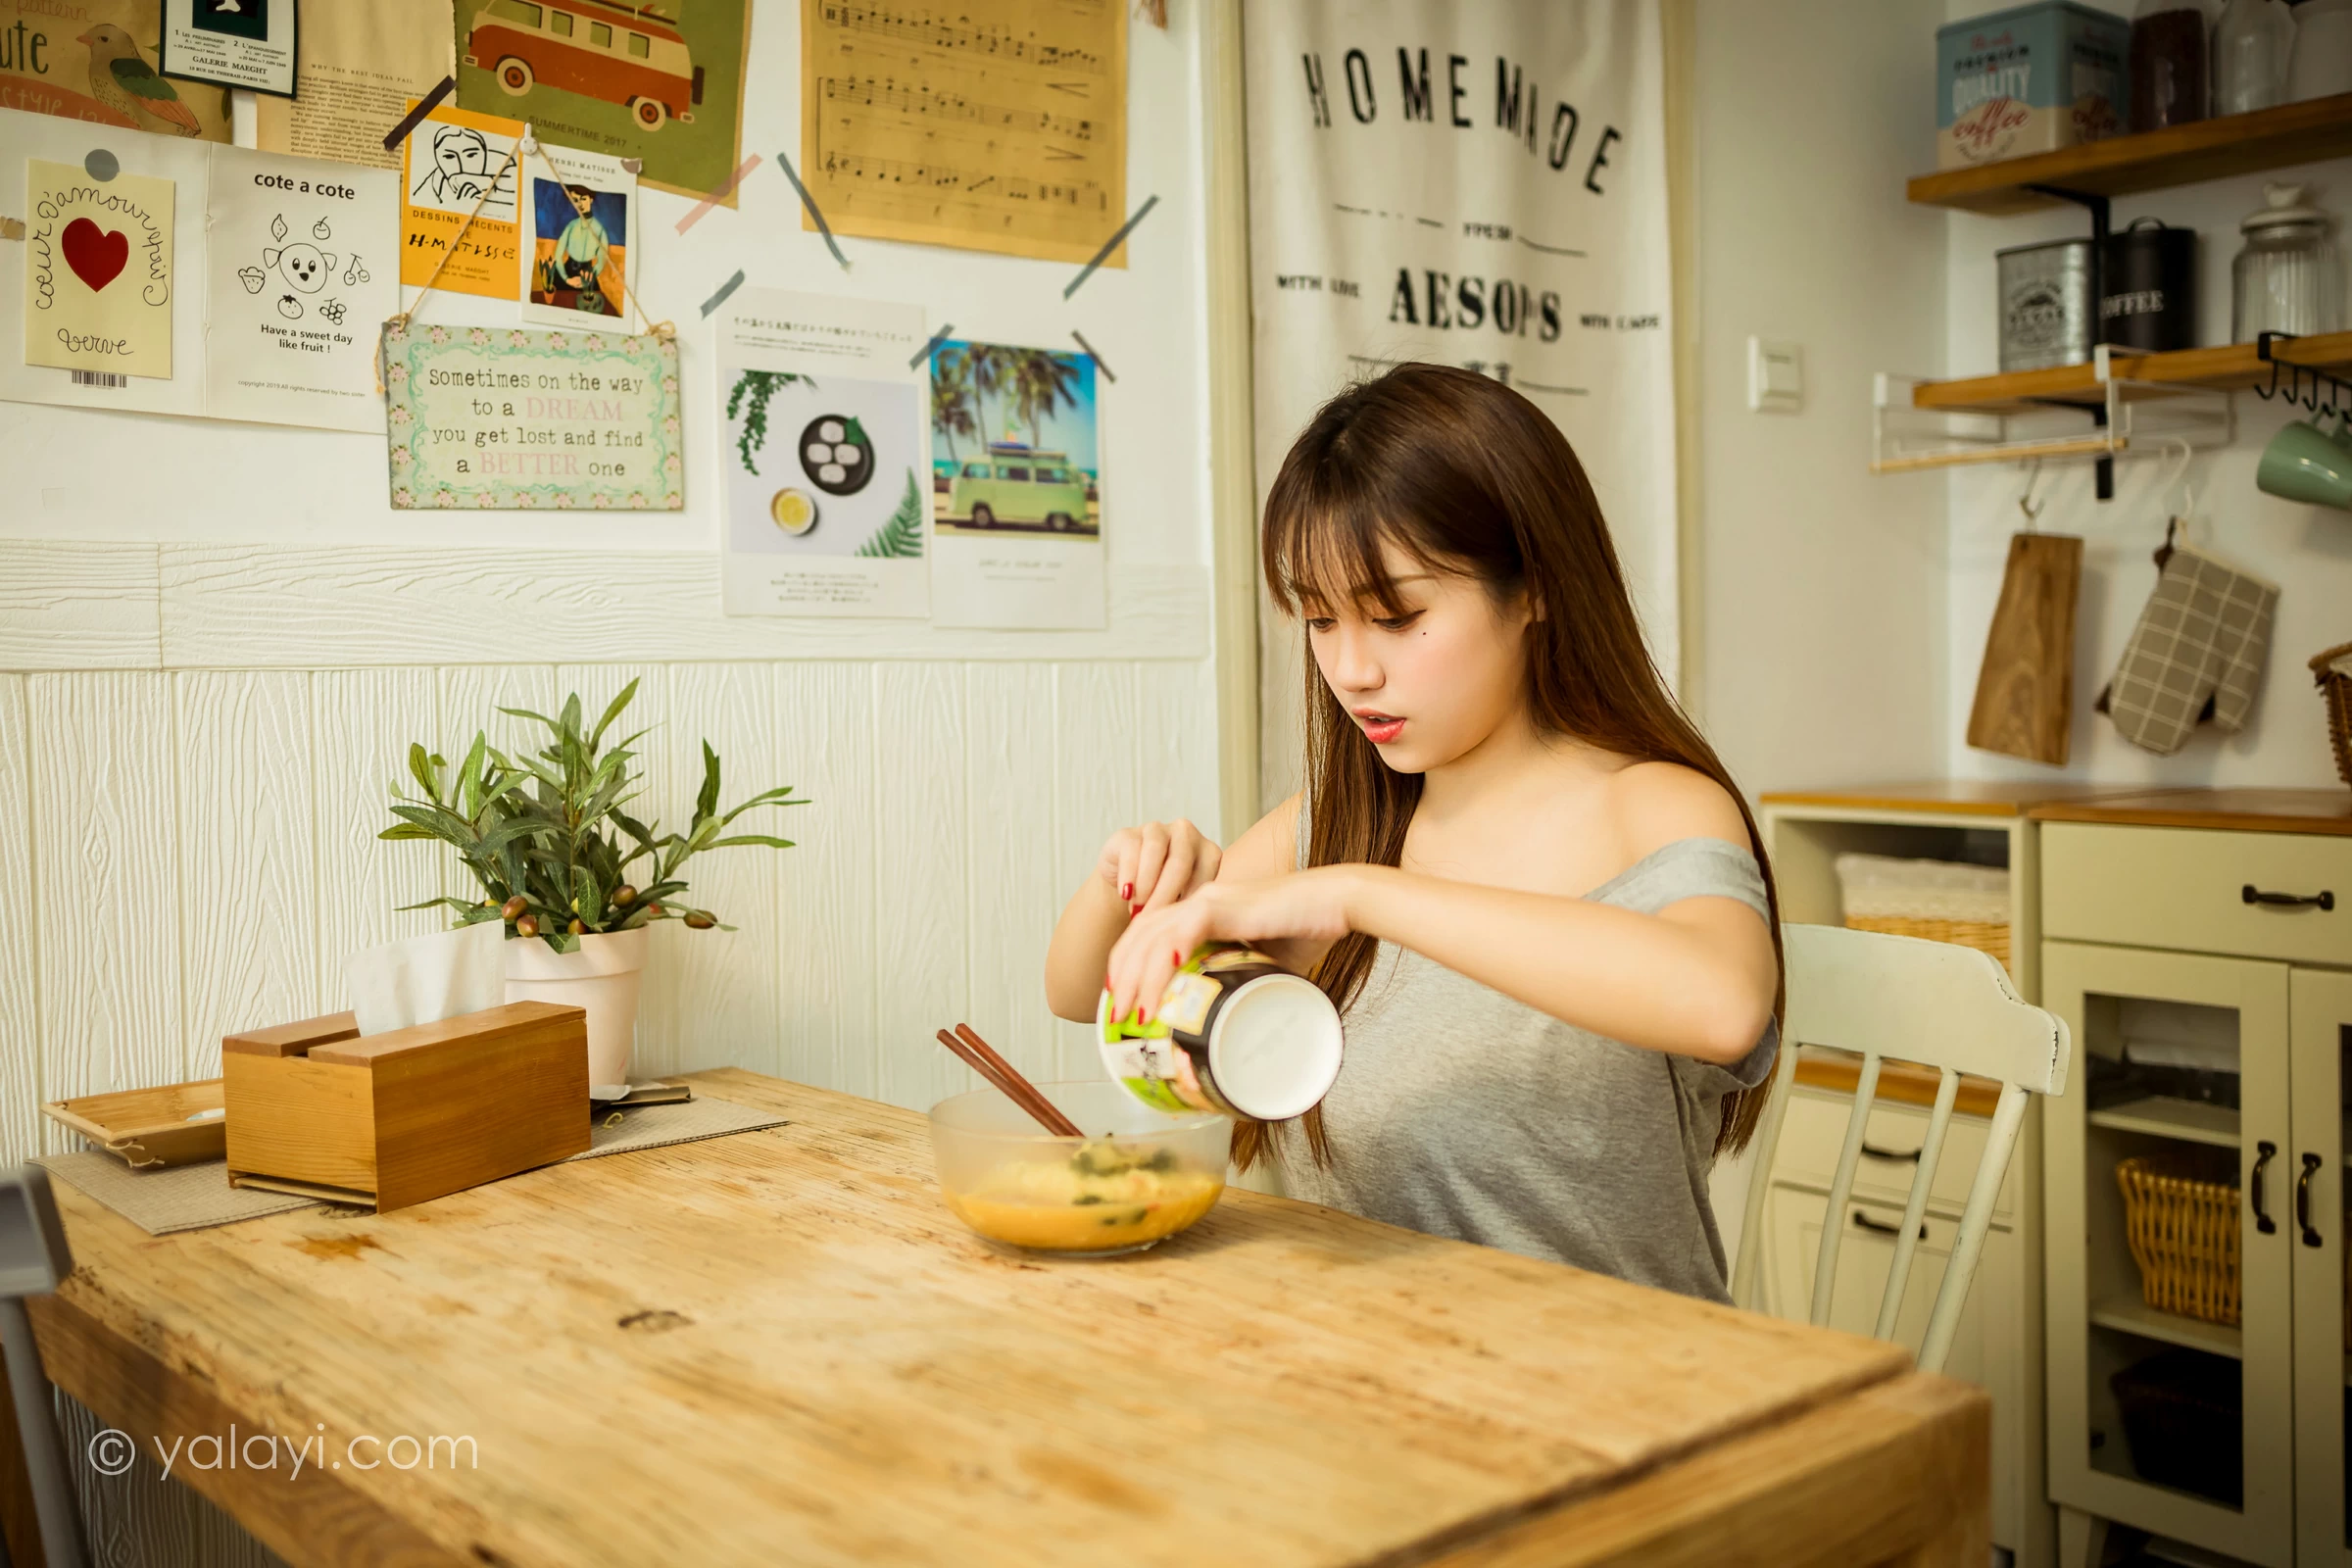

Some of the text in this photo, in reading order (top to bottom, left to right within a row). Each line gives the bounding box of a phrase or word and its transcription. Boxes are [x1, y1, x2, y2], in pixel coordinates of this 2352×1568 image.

[193, 56, 268, 74] GALERIE MAEGHT
[372, 73, 393, 81] IDEAS
[1952, 63, 2031, 117] QUALITY
[529, 116, 626, 147] SUMMERTIME 2017
[1952, 95, 2029, 148] coffee
[548, 157, 615, 174] HENRI MATISSE
[254, 174, 355, 200] cote a cote
[413, 210, 460, 224] DESSINS
[409, 234, 514, 260] H-MTISSE
[1388, 267, 1563, 343] AESOPS
[261, 323, 287, 336] Have
[300, 330, 330, 341] sweet
[333, 332, 353, 345] day
[279, 339, 298, 350] like
[301, 341, 323, 353] fruit
[429, 368, 643, 395] Sometimes on the way
[471, 397, 623, 422] to a DREAM
[432, 427, 643, 448] you get lost and find
[456, 452, 625, 476] a BETTER one
